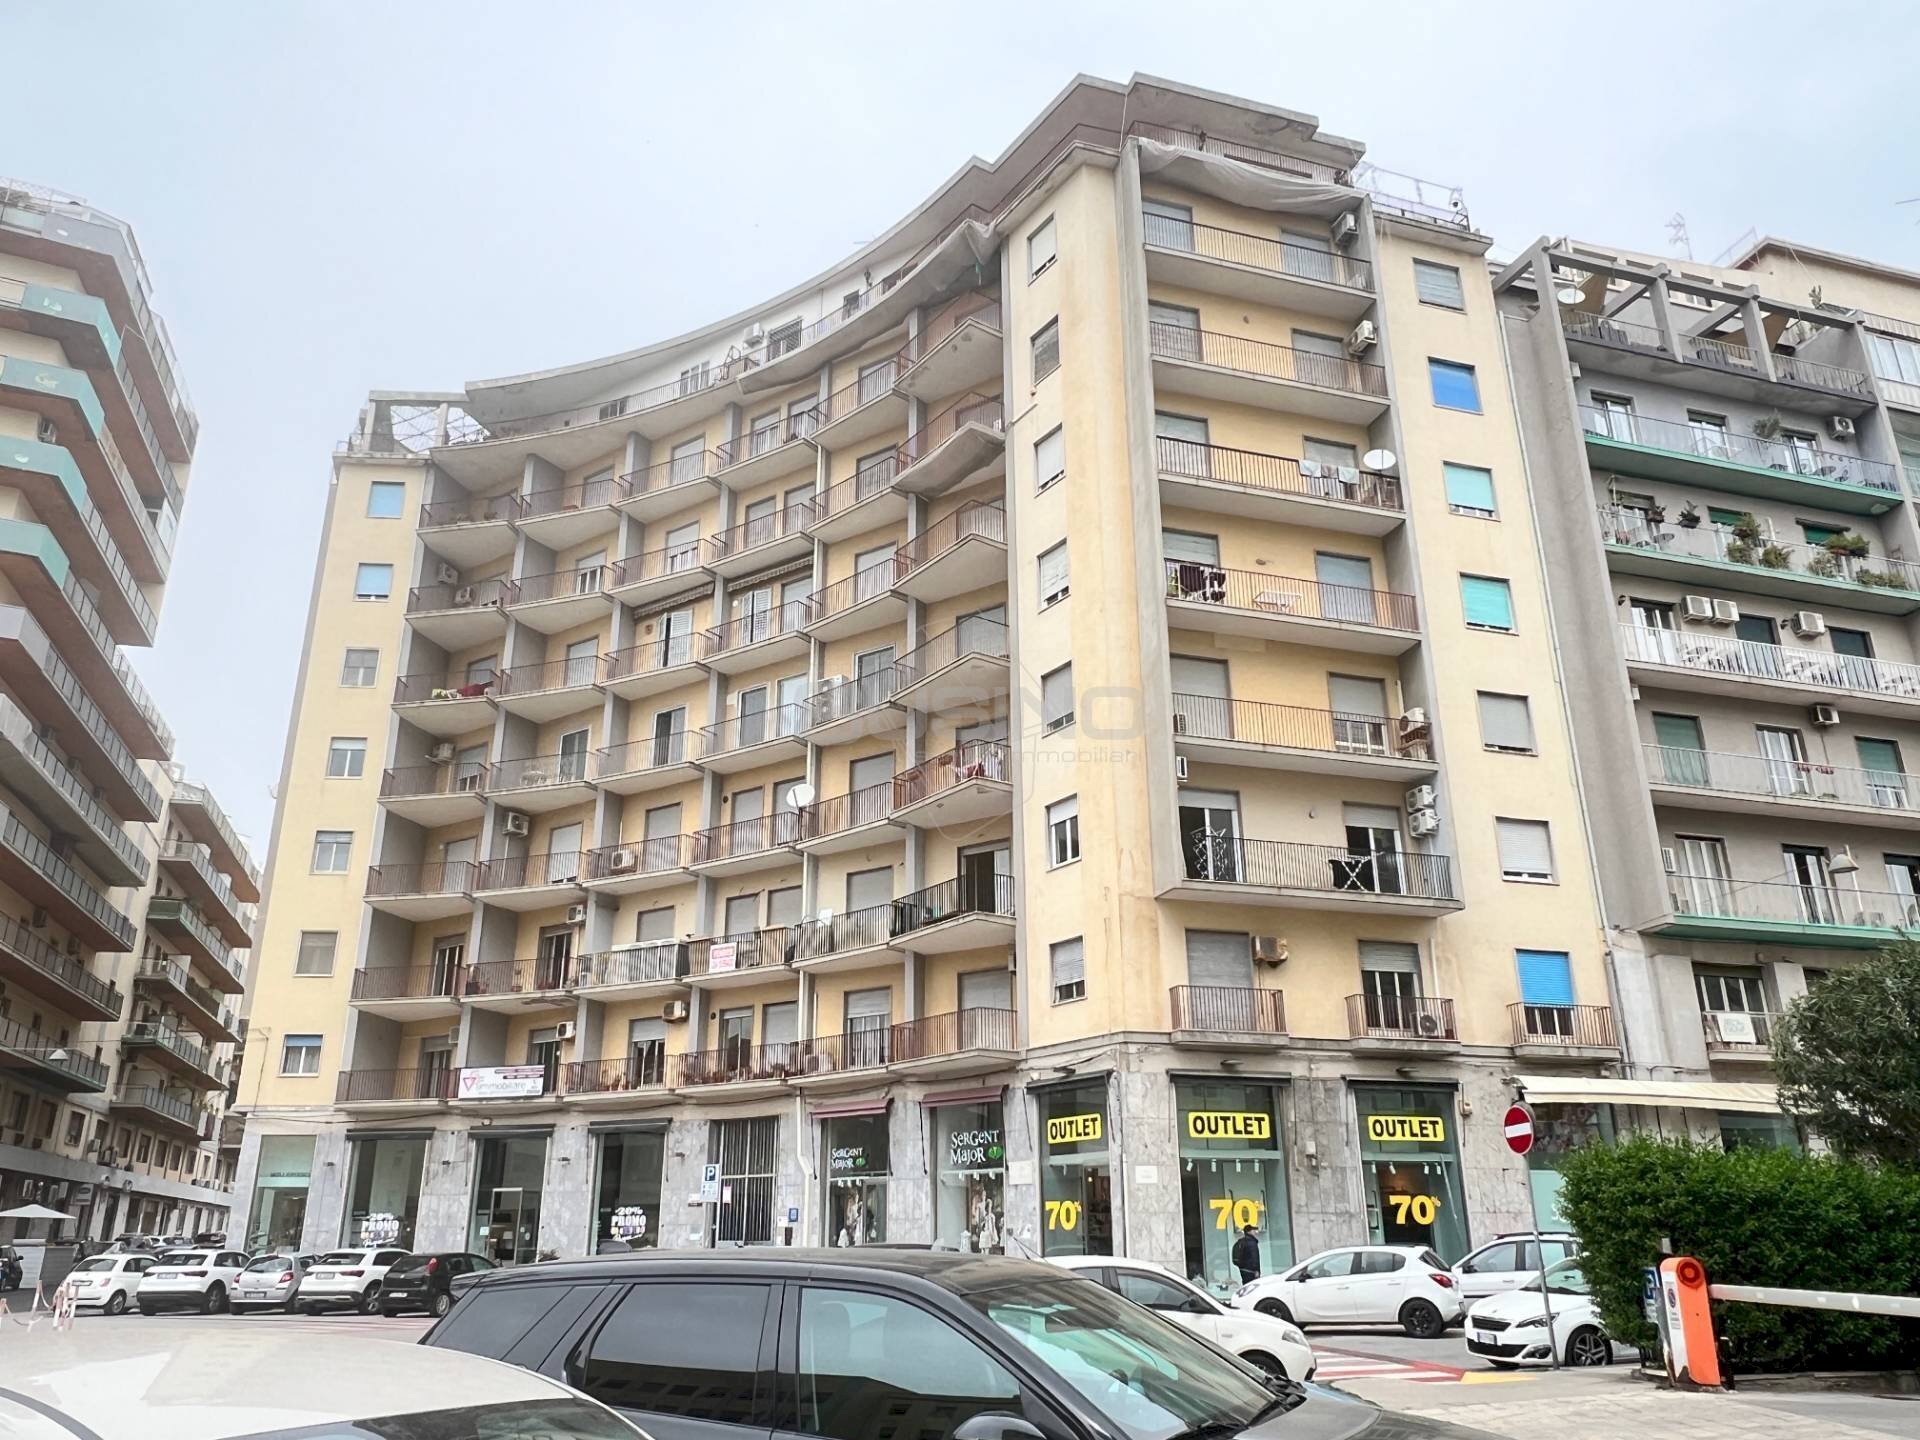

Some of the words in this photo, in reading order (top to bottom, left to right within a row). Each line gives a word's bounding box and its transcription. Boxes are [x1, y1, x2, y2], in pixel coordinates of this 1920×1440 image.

[1050, 1117, 1098, 1140] OUTLET
[1192, 1115, 1266, 1135] OUTLET
[1372, 1119, 1439, 1137] OUTLET
[611, 1215, 647, 1227] PROMO
